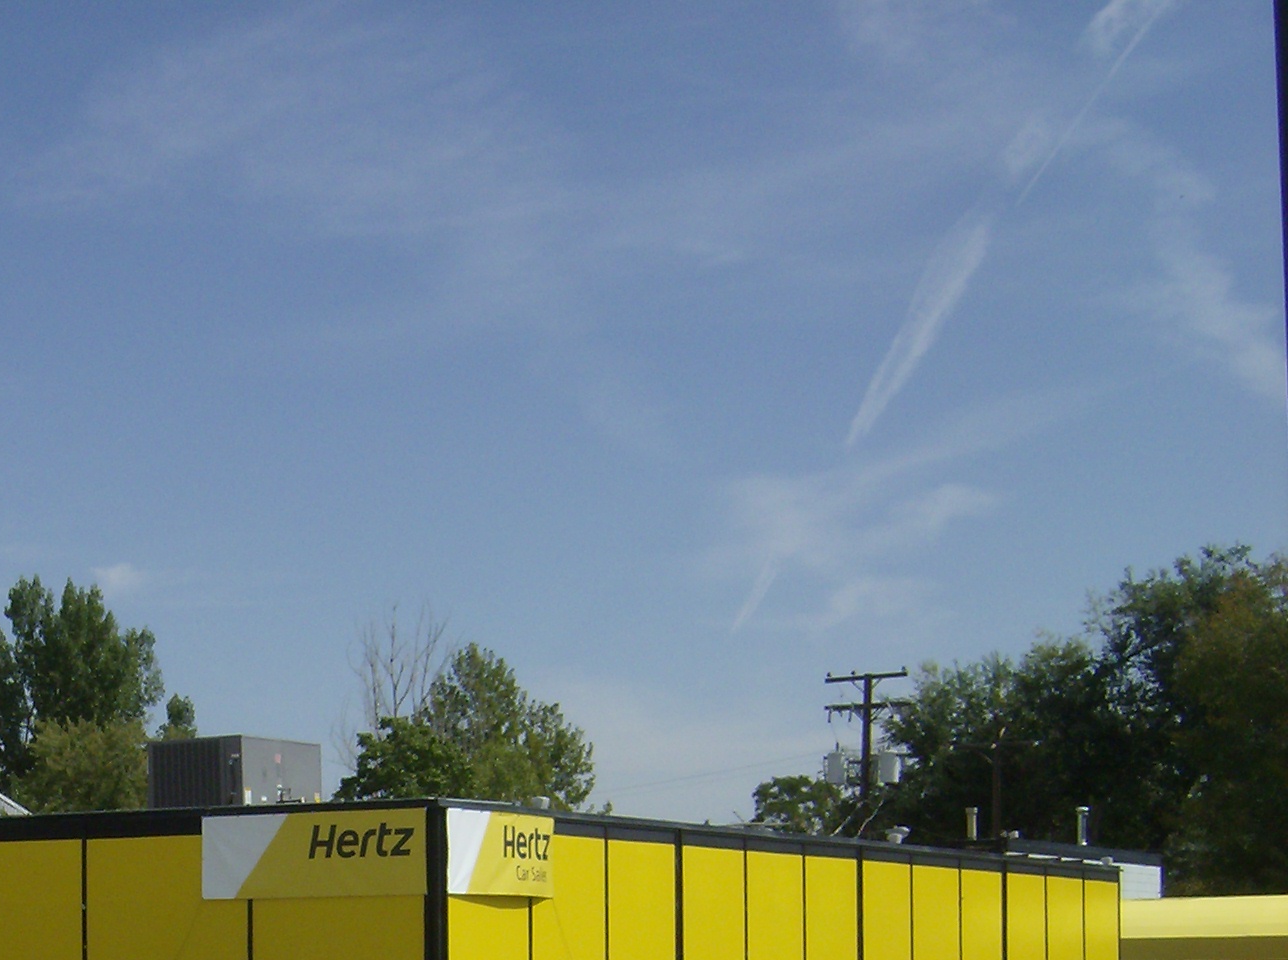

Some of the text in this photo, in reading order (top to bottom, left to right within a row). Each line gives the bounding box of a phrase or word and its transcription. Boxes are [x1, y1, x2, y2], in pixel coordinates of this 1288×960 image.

[309, 822, 414, 859] Hertz
[503, 825, 550, 860] Hertz
[516, 865, 530, 881] Car
